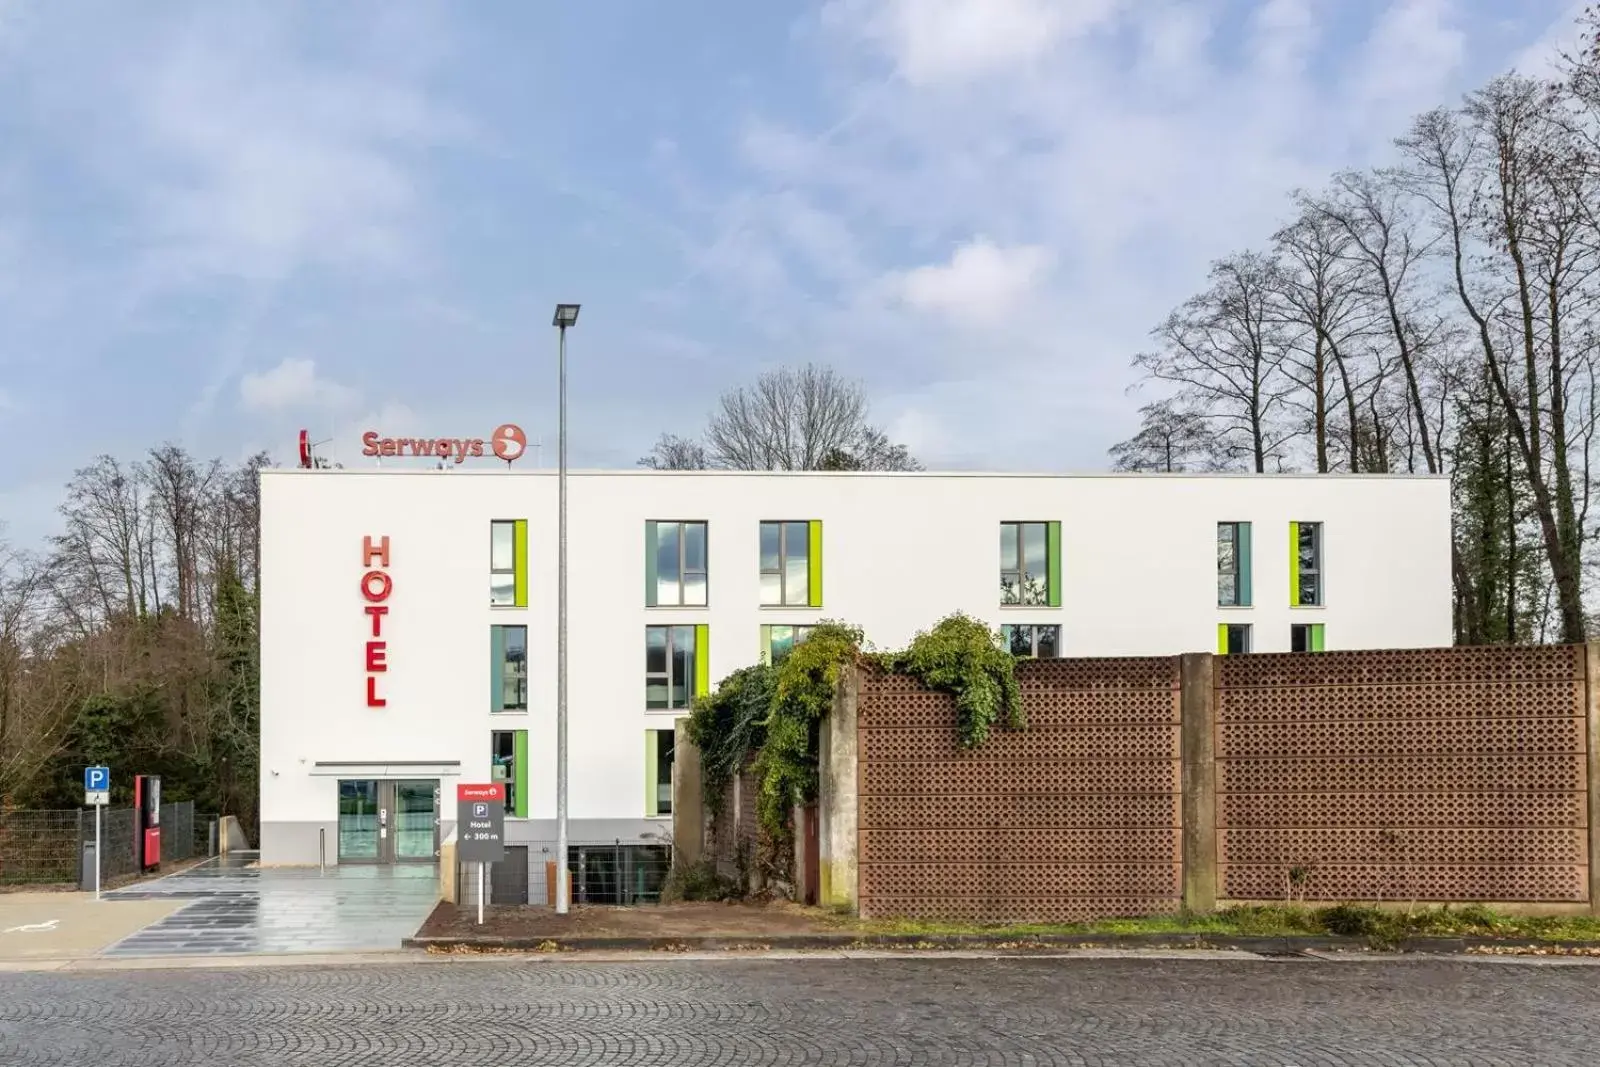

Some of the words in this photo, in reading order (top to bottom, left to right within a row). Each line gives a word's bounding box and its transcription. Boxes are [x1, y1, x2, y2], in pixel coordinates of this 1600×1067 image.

[362, 431, 484, 463] Serways
[361, 535, 392, 707] HOTEL
[91, 770, 103, 788] P
[476, 805, 485, 815] P
